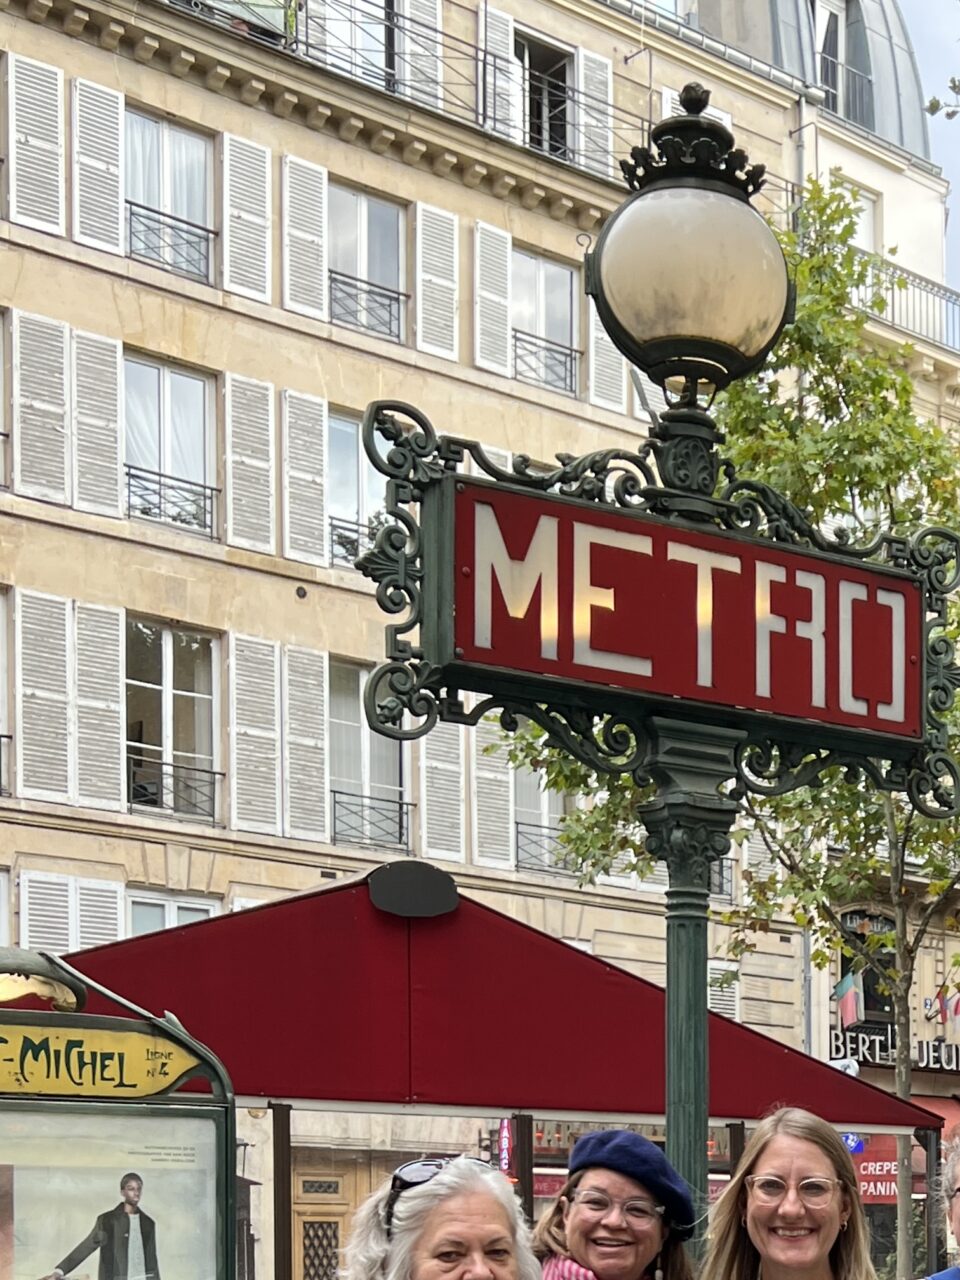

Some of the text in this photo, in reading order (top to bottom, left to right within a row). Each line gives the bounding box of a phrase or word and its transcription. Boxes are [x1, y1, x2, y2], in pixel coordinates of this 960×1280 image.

[474, 501, 905, 723] METRO
[159, 1061, 169, 1078] 4
[860, 1161, 898, 1175] CREPE
[860, 1181, 899, 1196] PANIN
